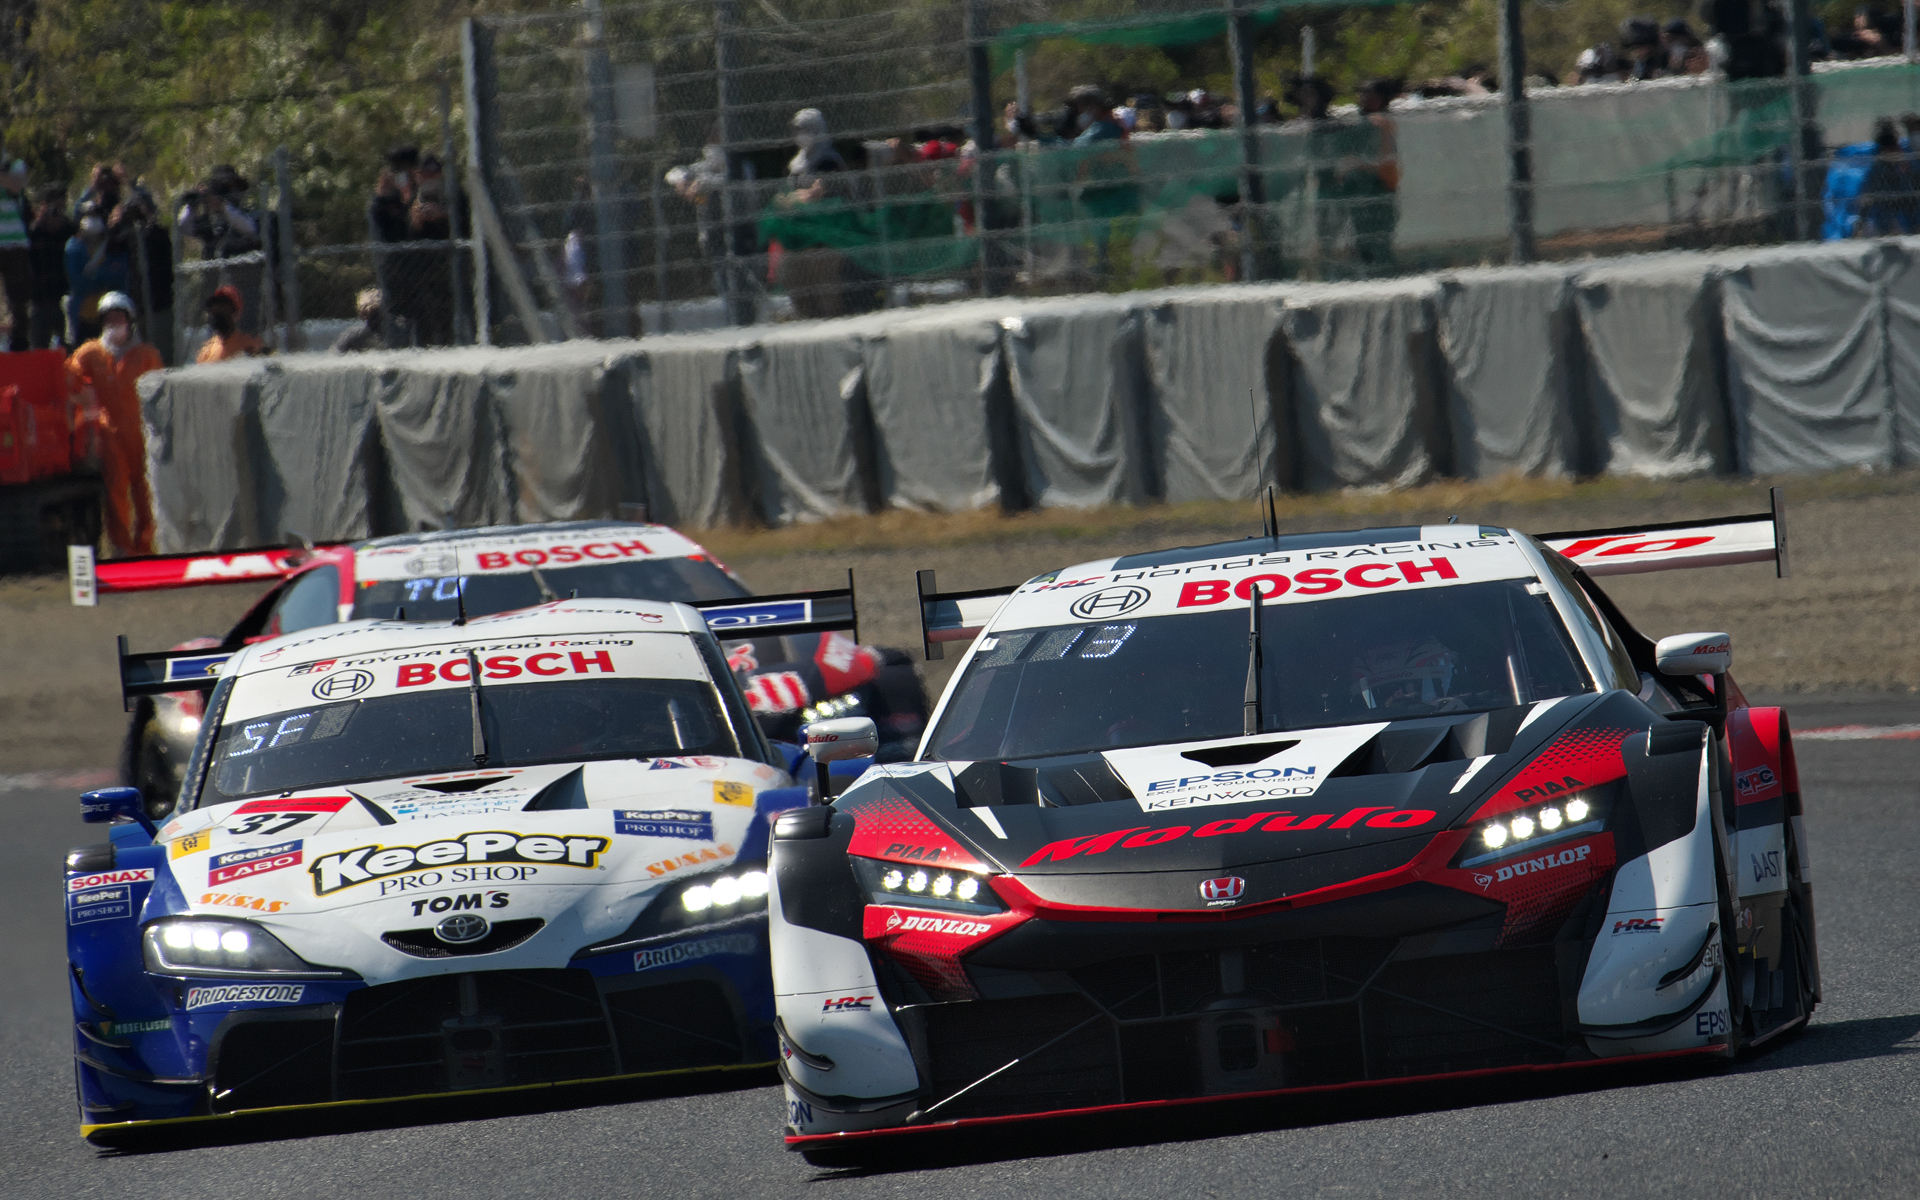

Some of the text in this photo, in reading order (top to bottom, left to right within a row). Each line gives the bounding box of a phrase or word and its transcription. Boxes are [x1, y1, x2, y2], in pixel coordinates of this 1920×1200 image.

[475, 540, 653, 570] BOSCH
[1032, 575, 1106, 594] HRC
[1306, 539, 1501, 561] RACING
[1176, 557, 1460, 609] BOSCH
[343, 649, 443, 668] TOYOTA
[450, 640, 541, 655] GAZOO
[549, 637, 634, 649] Racing
[396, 650, 616, 688] BOSCH
[229, 712, 311, 757] SF
[1146, 784, 1208, 797] EXCEED
[1262, 775, 1315, 783] VISION
[1147, 766, 1317, 792] EPSON
[1514, 775, 1585, 803] PIAA
[1148, 786, 1314, 809] KENWOOD
[228, 813, 319, 835] 37
[624, 811, 704, 823] KeePer
[624, 823, 704, 837] PRO SHOP
[1018, 806, 1437, 868] Modulo
[217, 843, 294, 868] KeePer
[311, 831, 609, 897] KeePer
[883, 843, 943, 863] PIAA
[1495, 844, 1592, 882] DUNLOP
[71, 869, 149, 890] SONAX
[217, 856, 295, 882] LABO
[379, 866, 538, 896] PRO SHOP
[77, 891, 123, 905] KeePer
[197, 892, 290, 913] SUSAS
[411, 890, 510, 916] TOM'S
[77, 905, 125, 919] PRO SHOP
[900, 916, 992, 937] DUNLOP
[1612, 918, 1665, 934] HRC
[186, 984, 304, 1010] BRIDGESTONE
[822, 995, 875, 1012] HRC
[1696, 1007, 1730, 1036] EPSO
